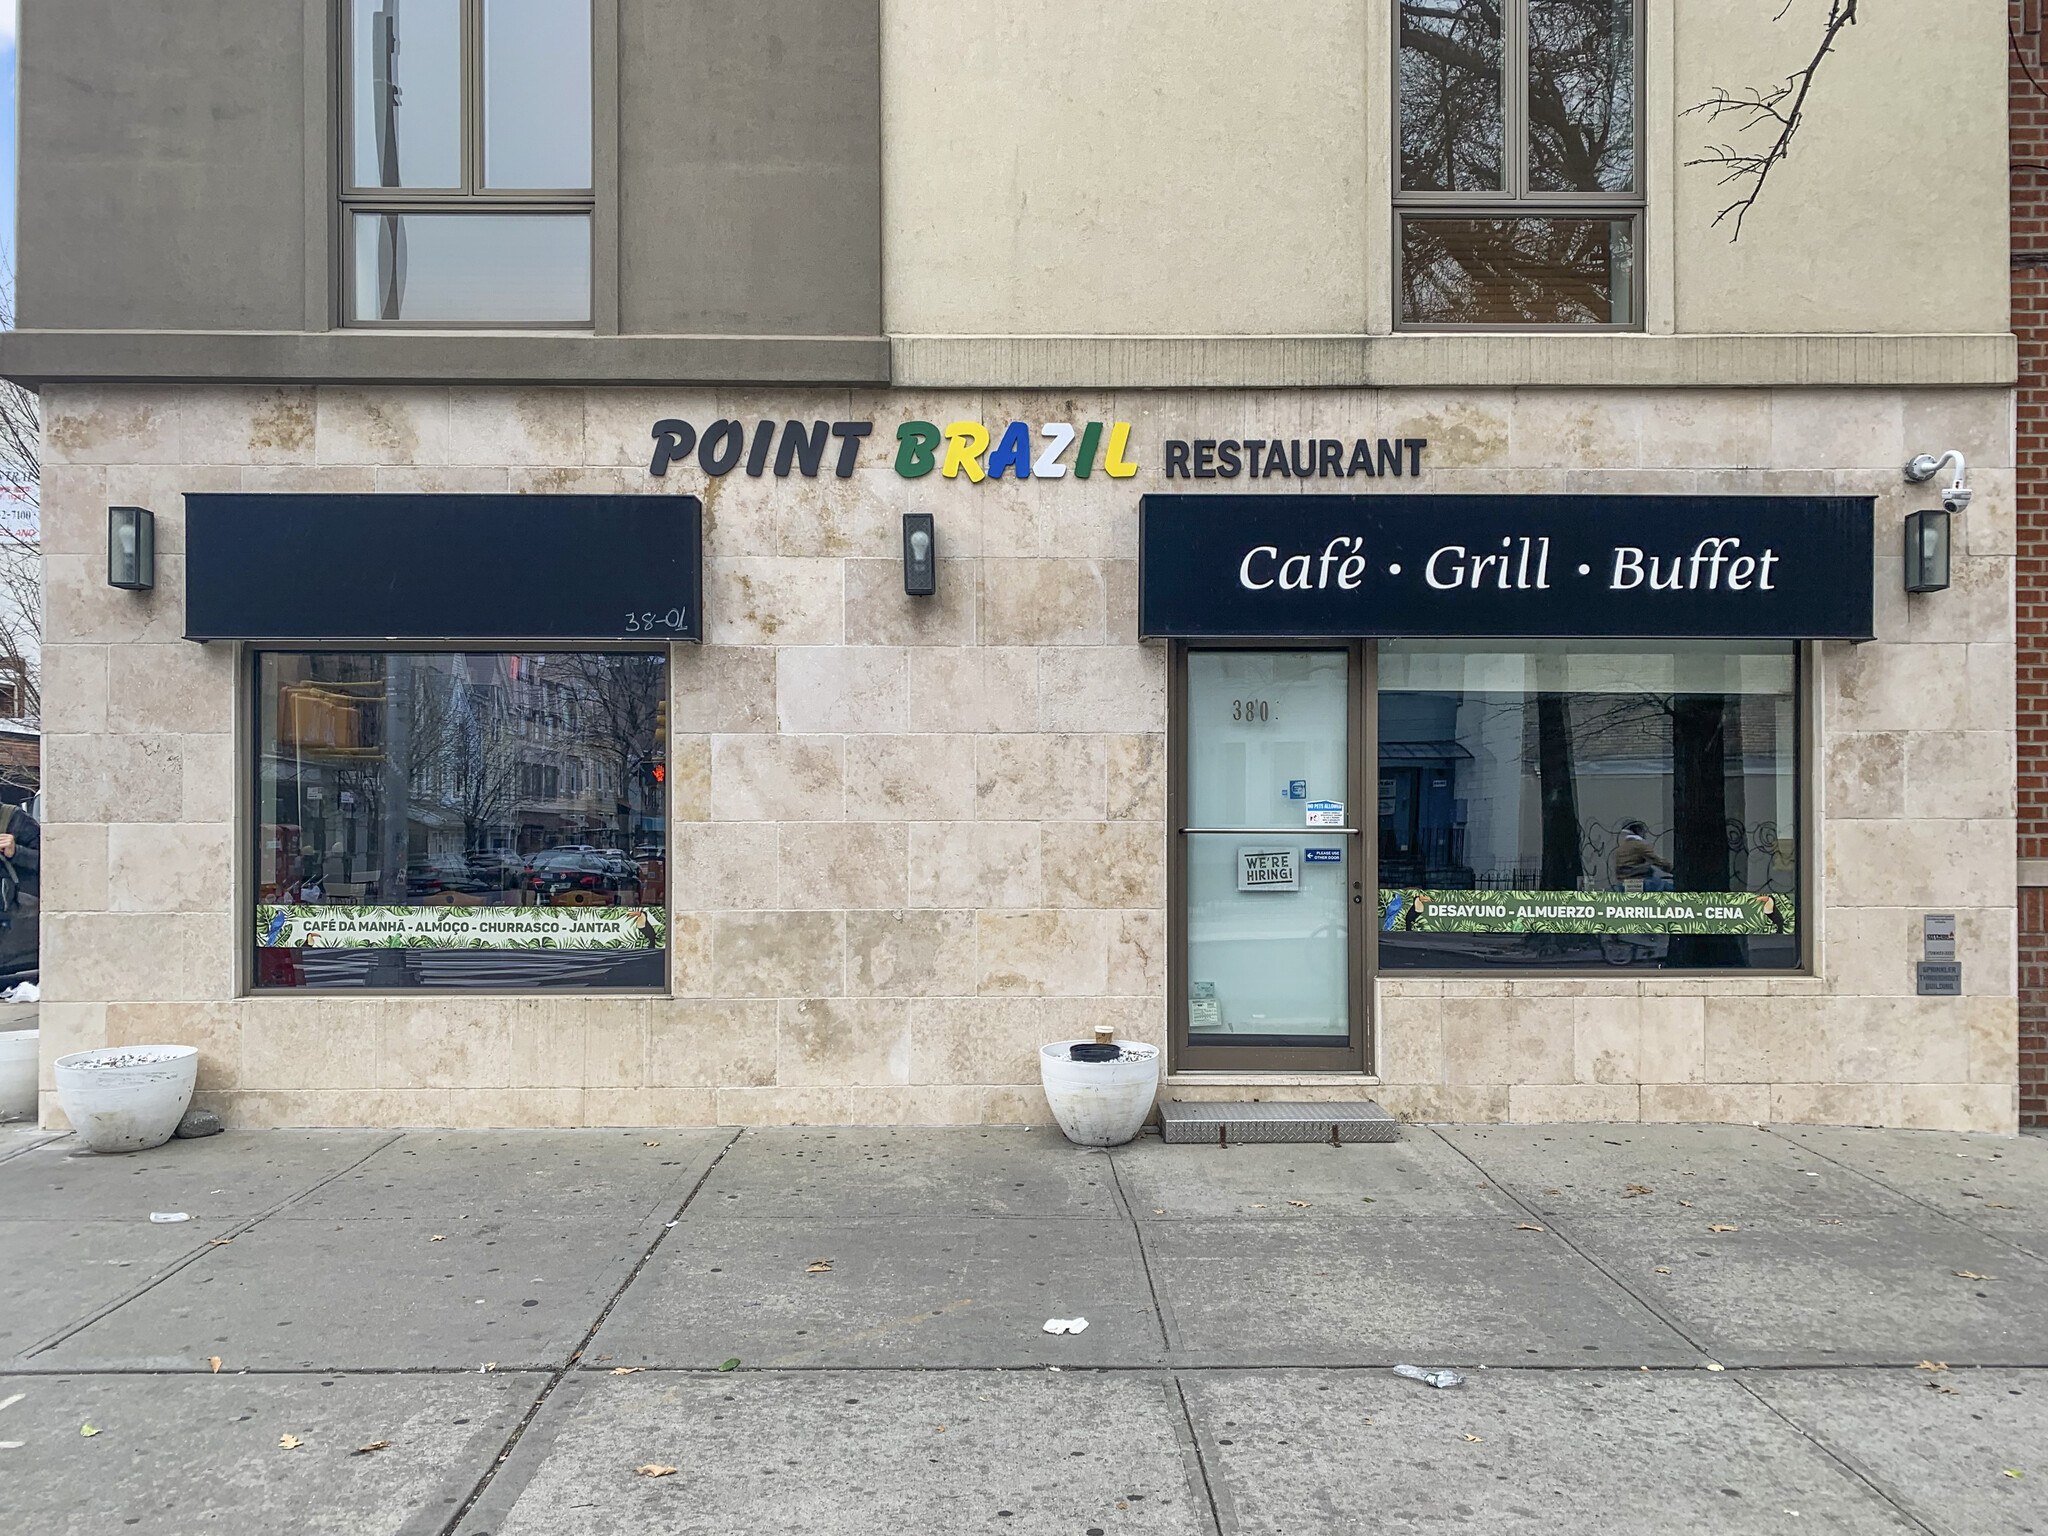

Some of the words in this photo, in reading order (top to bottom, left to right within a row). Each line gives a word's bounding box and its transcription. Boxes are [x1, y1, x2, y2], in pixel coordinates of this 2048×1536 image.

[649, 419, 873, 478] POINT
[895, 421, 1138, 483] BRAZIL
[1165, 438, 1428, 478] RESTAURANT
[1238, 536, 1367, 590] Café
[1425, 537, 1551, 590] Grill
[1609, 537, 1780, 590] Buffet
[625, 606, 688, 632] 38-01
[1246, 855, 1289, 869] WE'RE
[1247, 868, 1293, 881] HIRING!
[1428, 904, 1506, 917] DESAYUNO
[1516, 906, 1595, 918] ALMUERZO
[1606, 906, 1695, 919] PARRILLADA
[1705, 907, 1744, 919] CENA
[303, 917, 337, 932] CAFÉ
[338, 920, 358, 932] DA
[359, 918, 407, 932] MANHÃ
[415, 920, 469, 936] ALMOÇO
[479, 921, 560, 933] CHURRASCO
[569, 921, 621, 933] JANTAR
